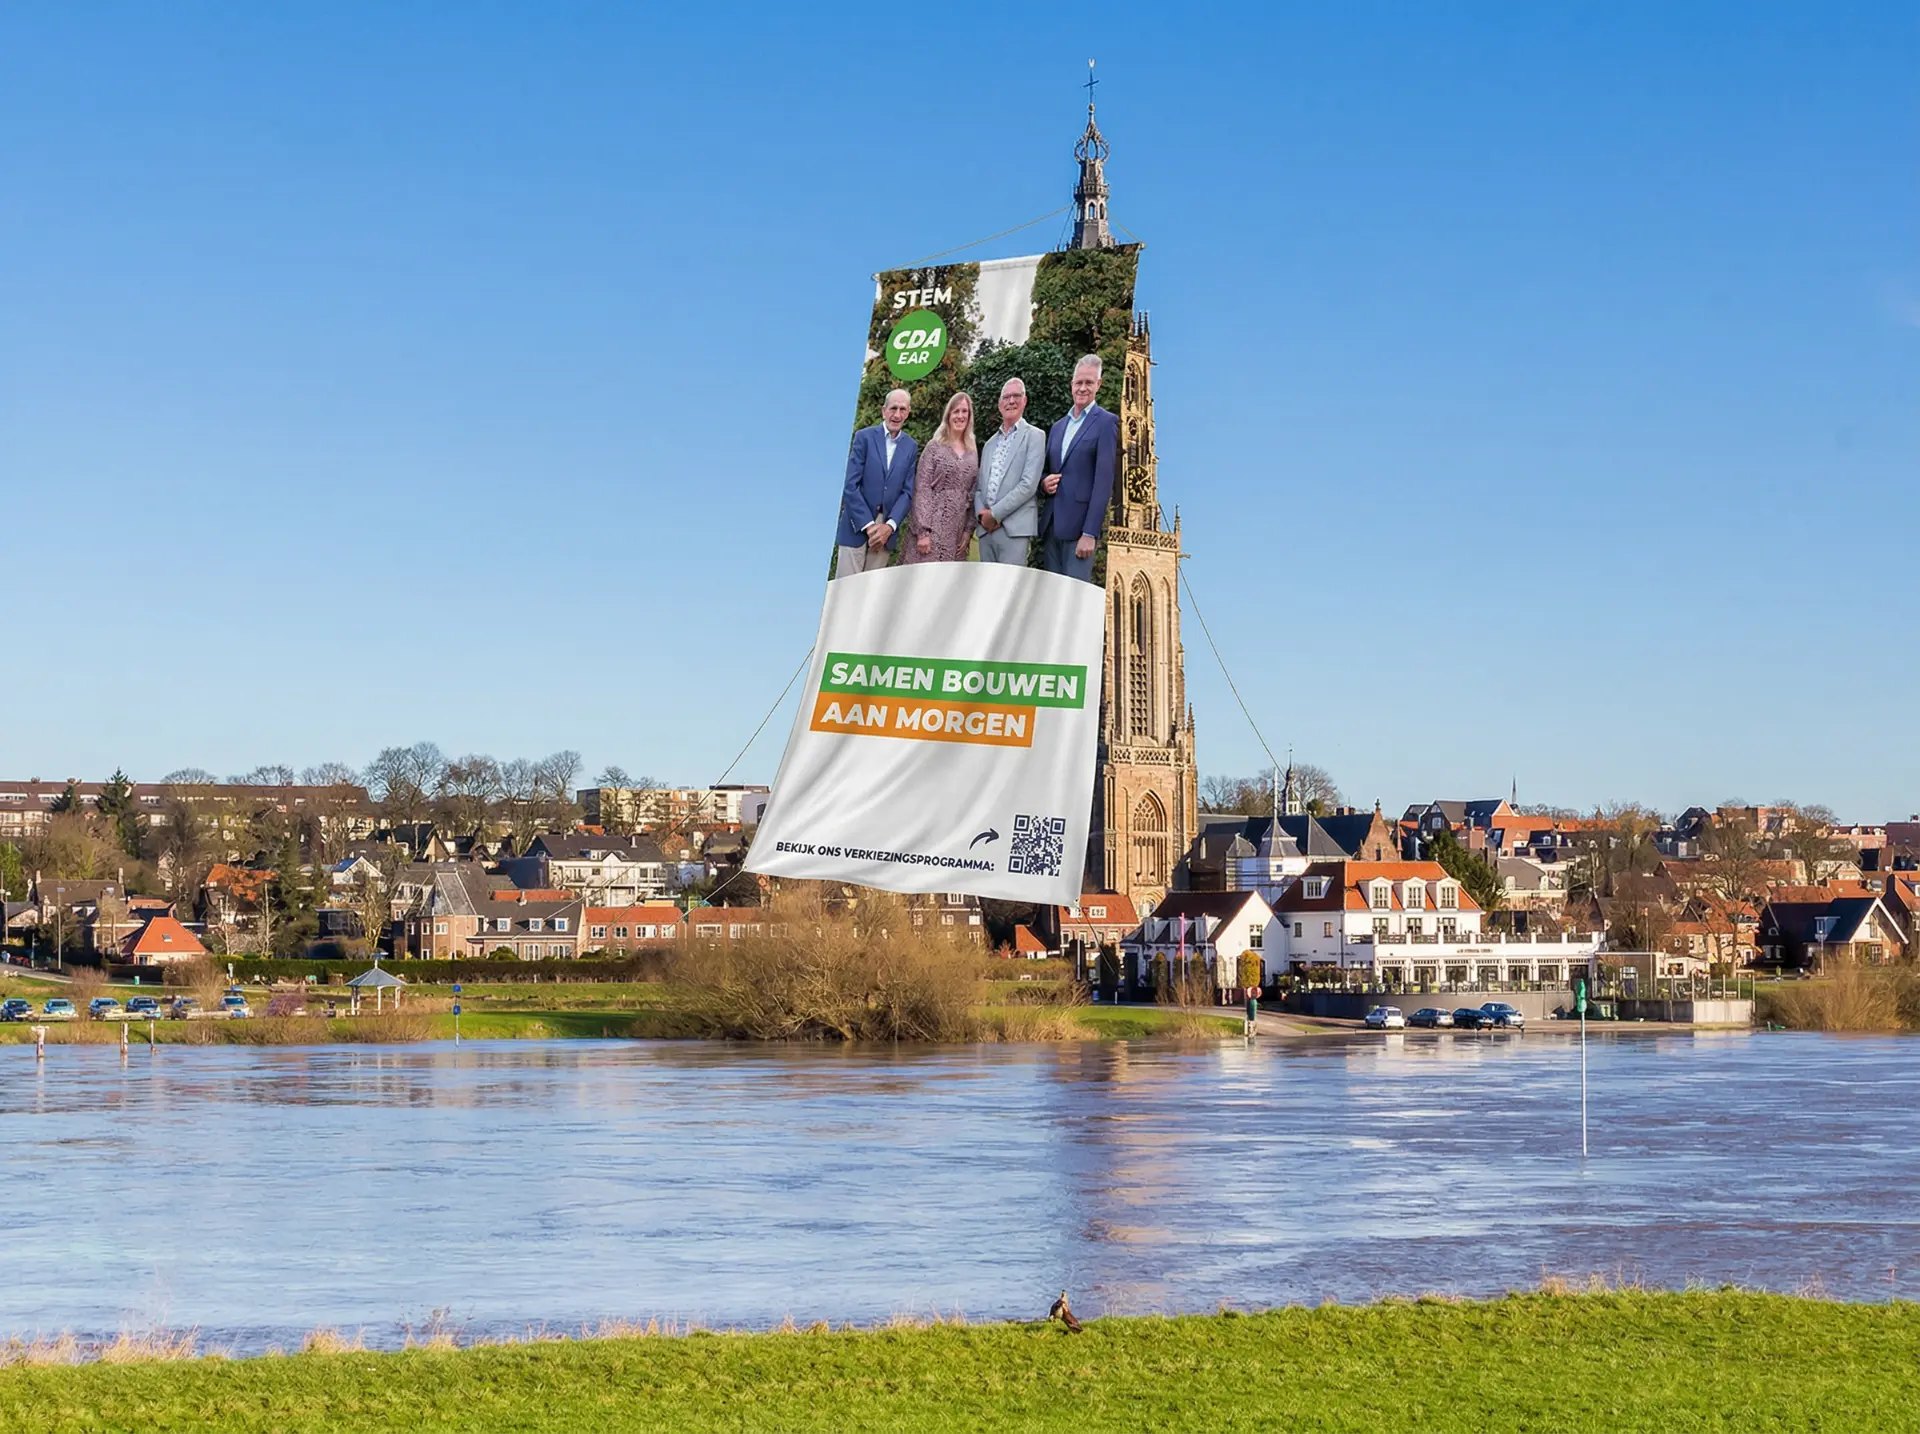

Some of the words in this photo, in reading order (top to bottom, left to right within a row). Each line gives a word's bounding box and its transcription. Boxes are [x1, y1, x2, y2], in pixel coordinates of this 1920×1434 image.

[893, 286, 952, 309] STEM
[893, 328, 941, 350] CDA
[897, 351, 930, 365] EAR
[829, 662, 933, 691] SAMEN
[942, 669, 1078, 699] BOUWEN
[821, 702, 888, 728] AAN
[895, 707, 1026, 738] MORGEN
[776, 841, 815, 855] BEKIJK
[818, 846, 842, 857] ONS
[844, 849, 995, 871] VERKIEZINGSPROGRAMMA:
